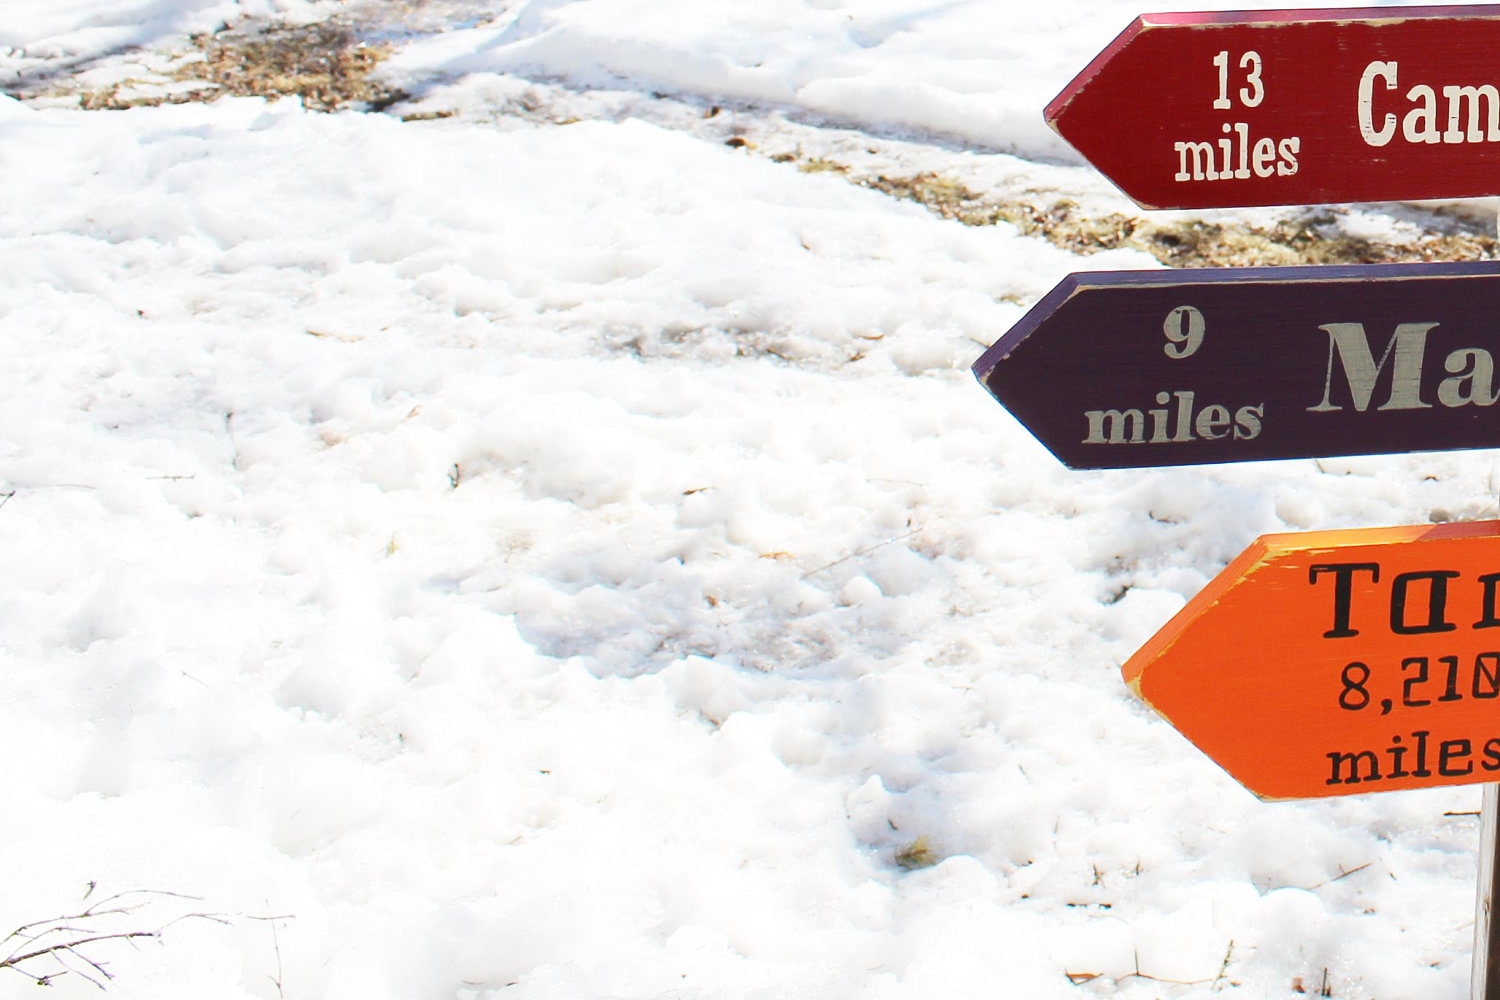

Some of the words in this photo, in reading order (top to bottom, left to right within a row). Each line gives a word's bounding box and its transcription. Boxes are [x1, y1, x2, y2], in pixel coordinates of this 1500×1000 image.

[1213, 50, 1263, 110] 13
[1174, 123, 1301, 183] miles
[1163, 305, 1205, 360] 9
[1082, 390, 1265, 445] miles
